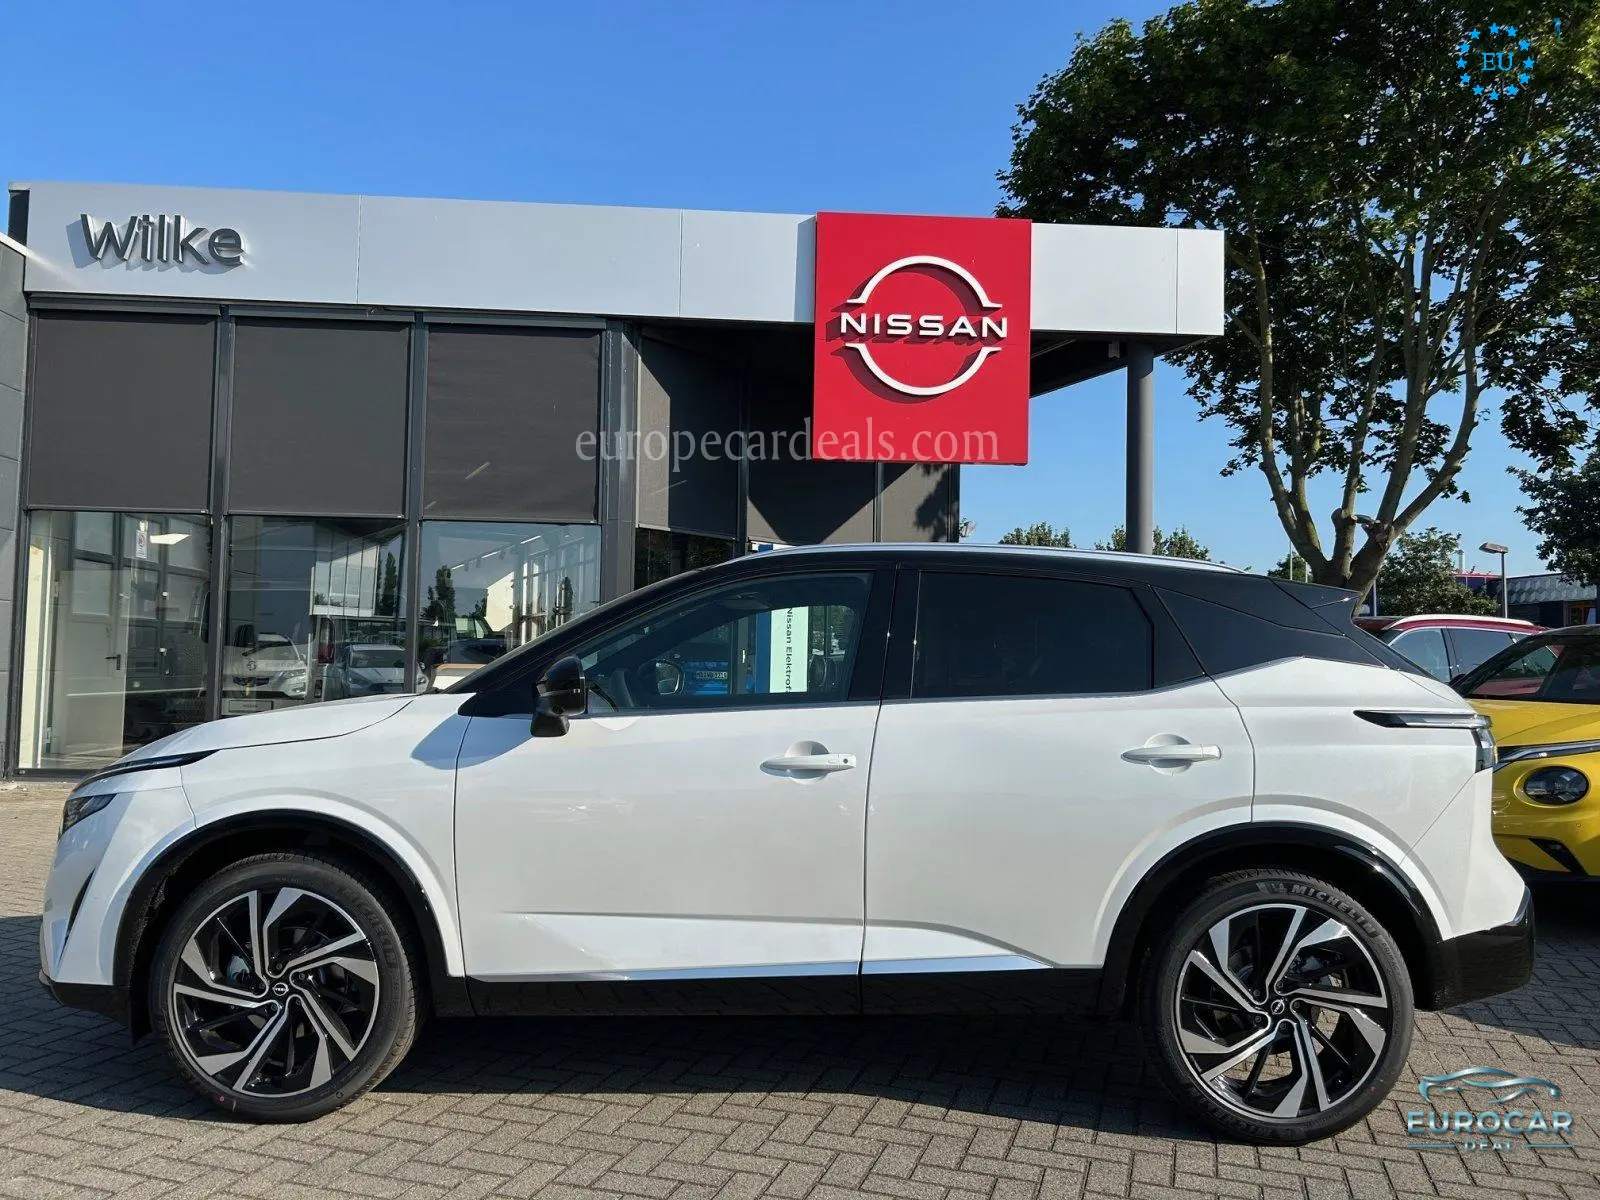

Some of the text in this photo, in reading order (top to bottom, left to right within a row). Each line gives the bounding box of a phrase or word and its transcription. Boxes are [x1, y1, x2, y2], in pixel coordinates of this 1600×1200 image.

[80, 213, 244, 267] Wilke
[840, 312, 1008, 339] NISSAN
[785, 646, 793, 692] Elektrof
[1292, 884, 1376, 935] MICHELIN
